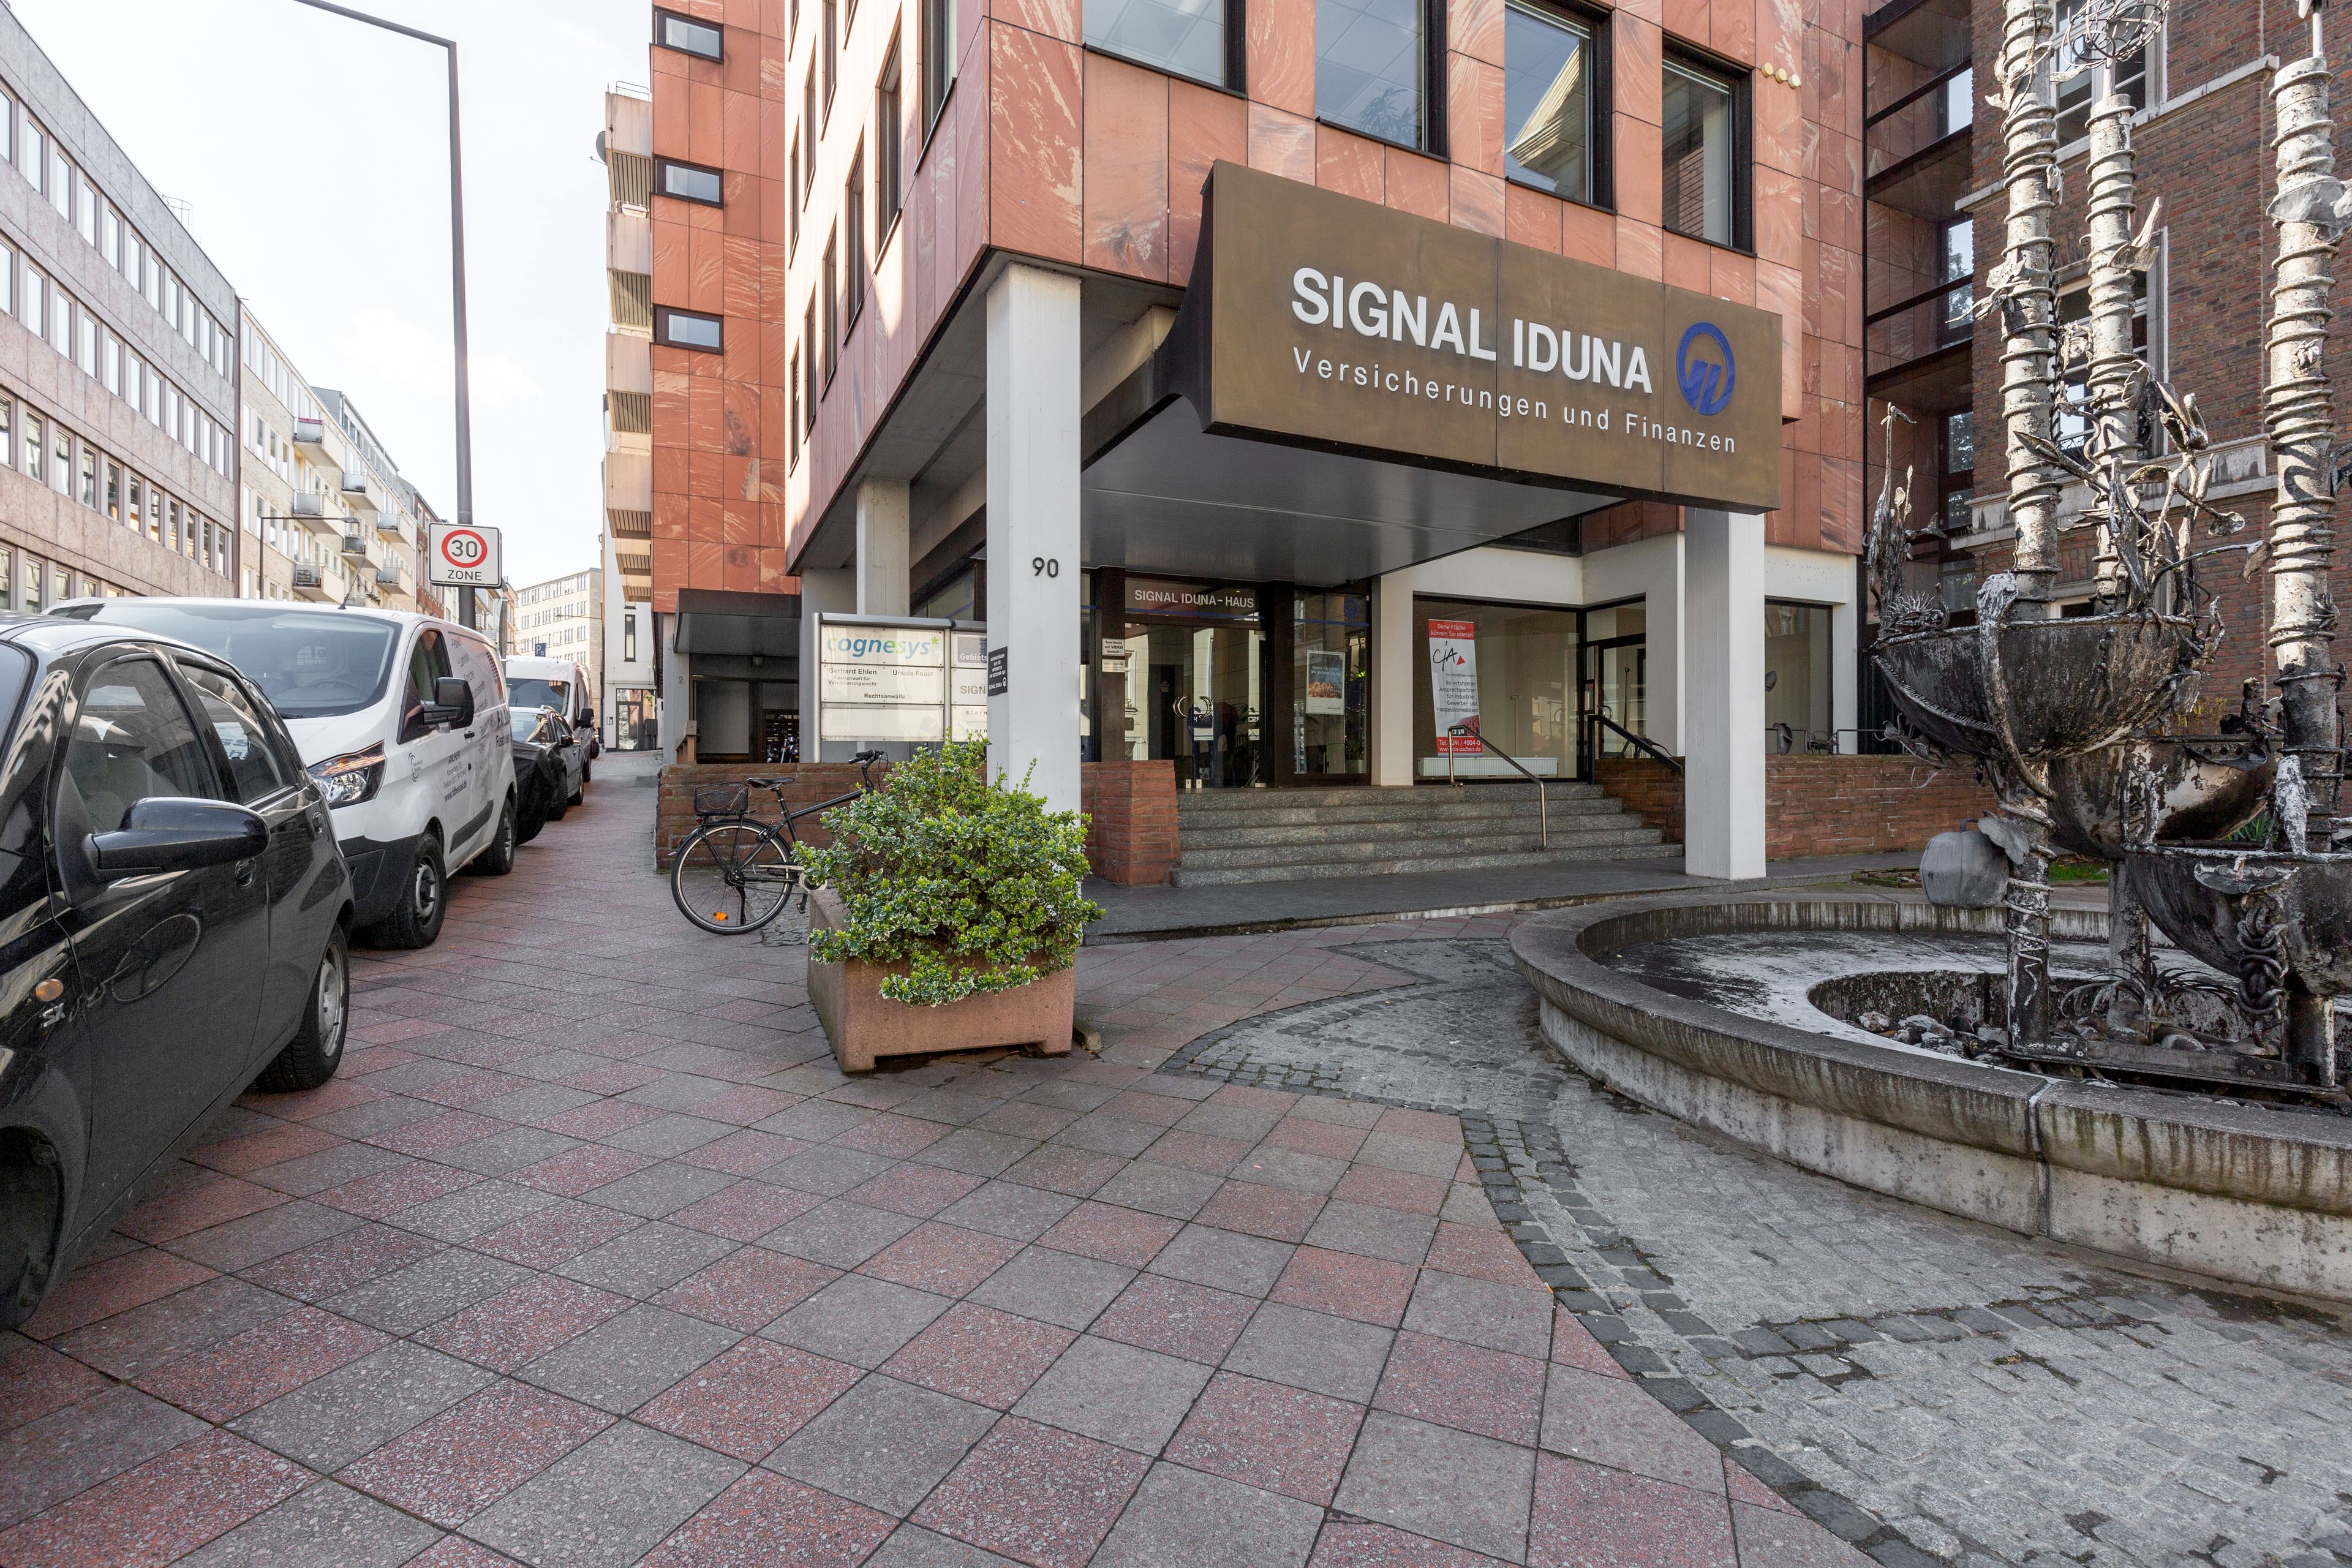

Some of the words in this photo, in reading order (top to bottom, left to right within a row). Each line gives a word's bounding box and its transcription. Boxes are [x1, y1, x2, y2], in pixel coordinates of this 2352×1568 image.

[1291, 267, 1496, 361] SIGNAL
[1513, 318, 1653, 394] IDUNA
[1292, 347, 1547, 419] Versicherungen
[1563, 405, 1609, 431] und
[1626, 413, 1735, 453] Finanzen
[451, 540, 478, 558] 30
[447, 570, 482, 581] ZONE
[1032, 557, 1059, 578] 90
[1134, 590, 1178, 603] SIGNAL
[536, 644, 541, 655] P
[827, 636, 930, 659] cognesys
[960, 685, 986, 695] SIGN
[42, 1003, 66, 1027] SX
